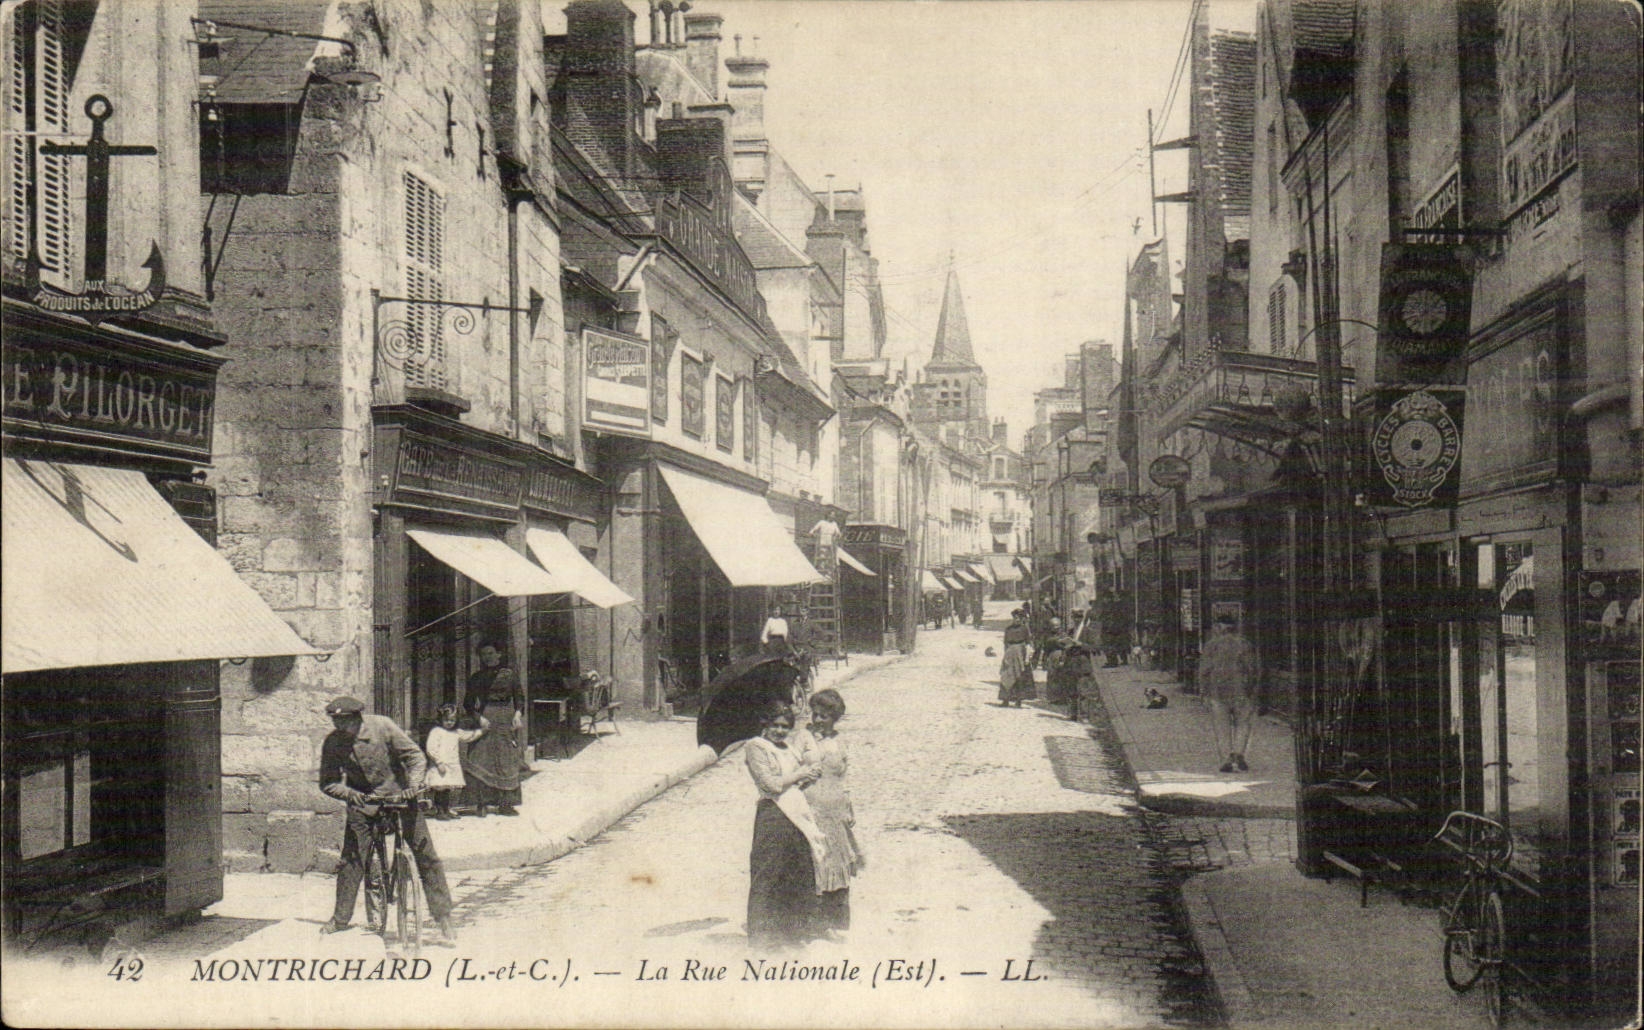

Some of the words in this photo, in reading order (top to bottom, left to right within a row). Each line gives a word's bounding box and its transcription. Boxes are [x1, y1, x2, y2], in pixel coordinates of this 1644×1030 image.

[33, 291, 91, 311] PRODUITS
[84, 280, 105, 296] AUX
[47, 351, 211, 440] PILORGET
[1377, 415, 1401, 463] CYCLES
[1436, 417, 1455, 467] BARRE
